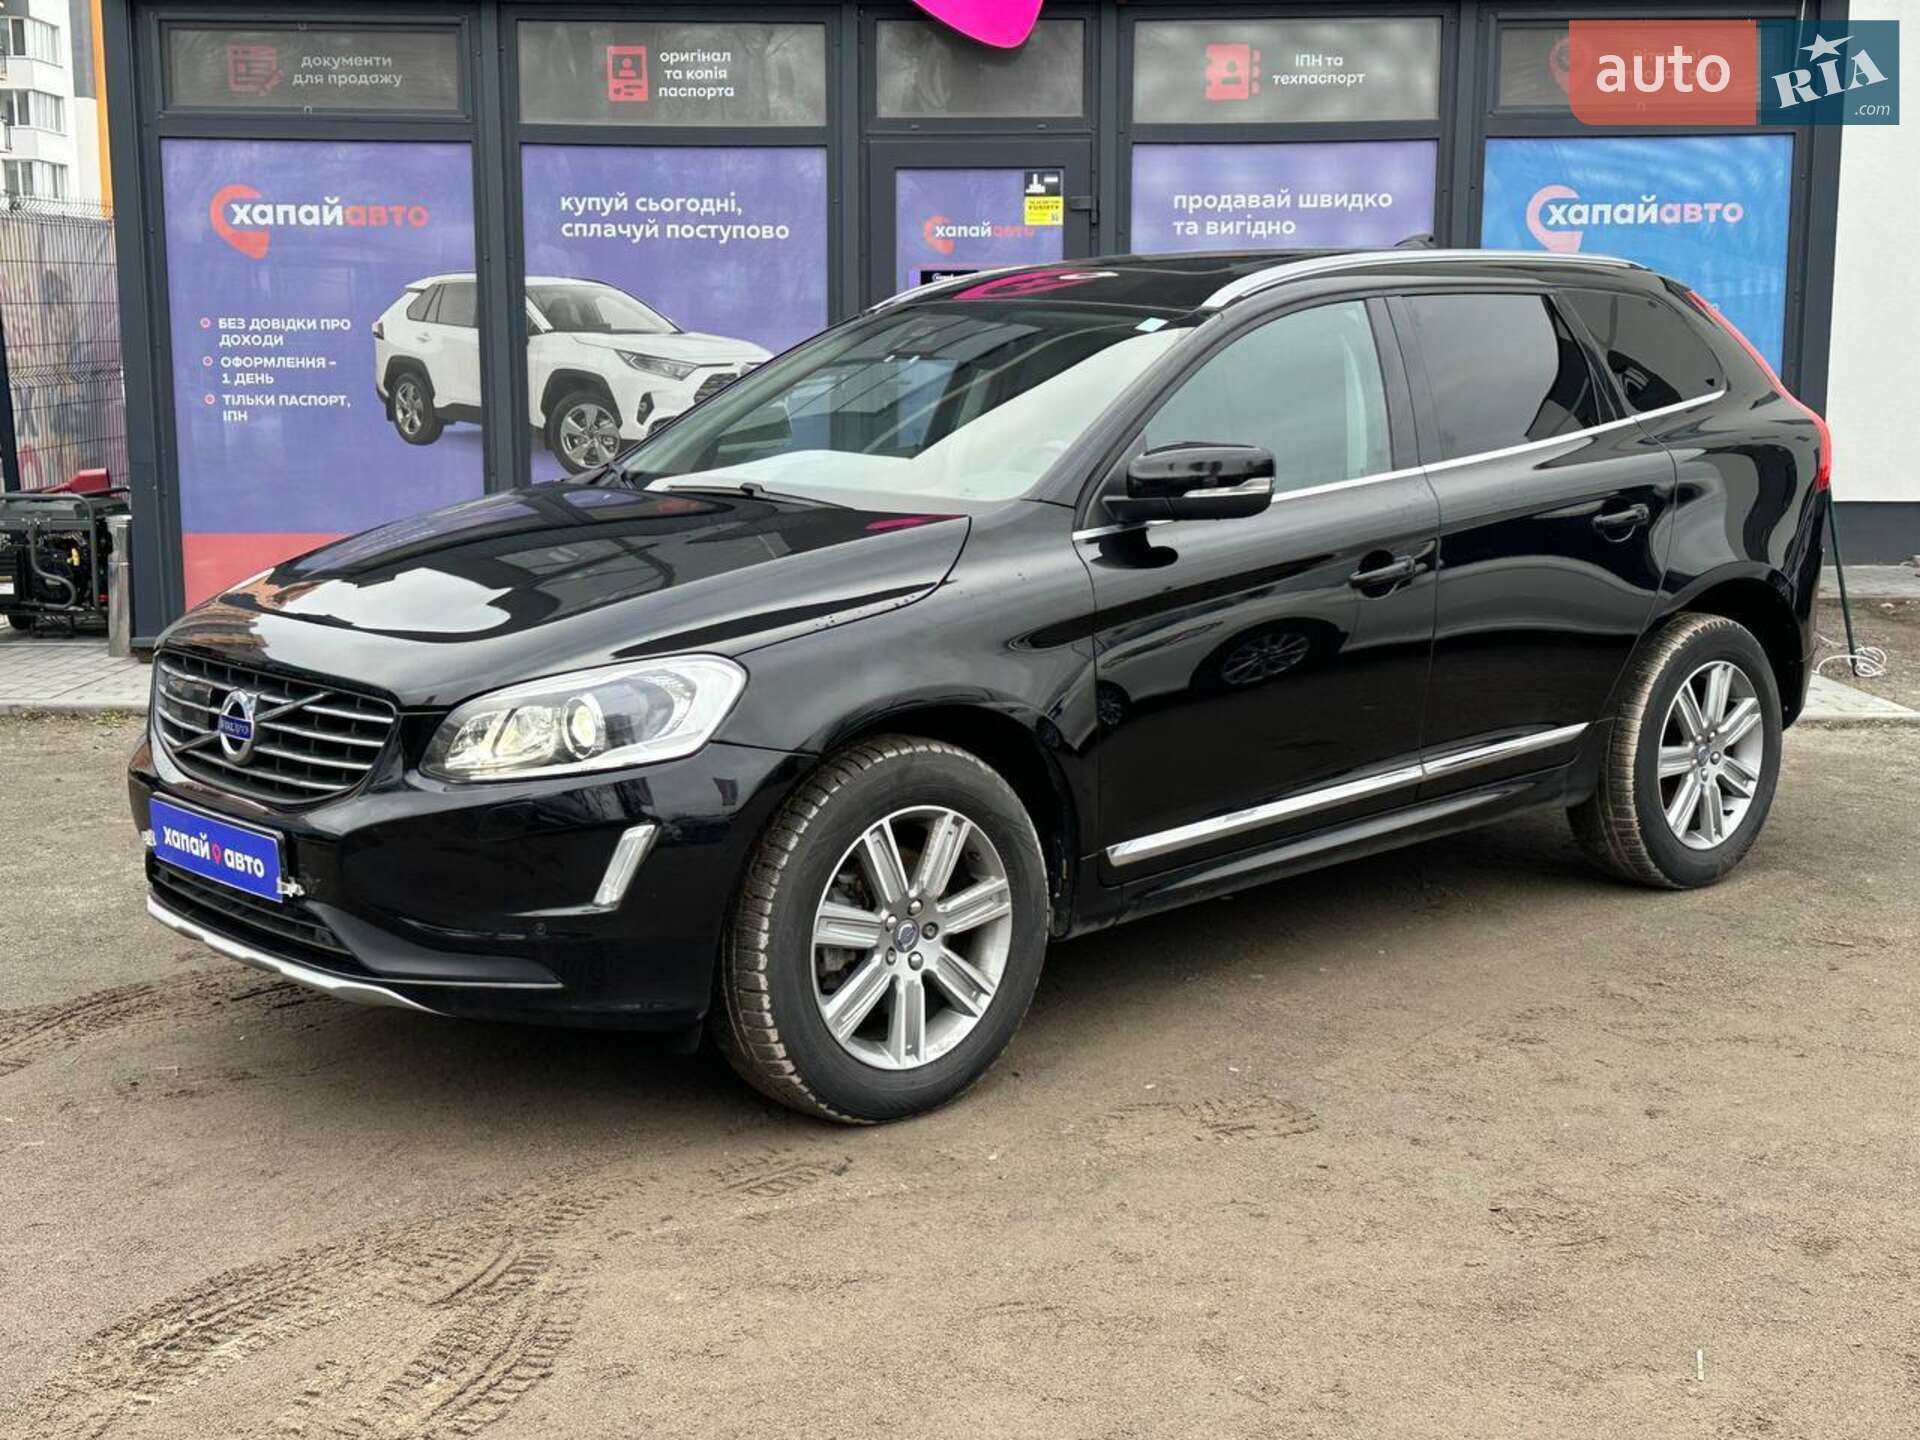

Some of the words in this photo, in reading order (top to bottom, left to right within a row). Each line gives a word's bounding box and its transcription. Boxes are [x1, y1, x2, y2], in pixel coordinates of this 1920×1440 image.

[301, 56, 392, 70] документи
[659, 49, 731, 65] оригінал
[1295, 54, 1322, 67] ІПН
[1325, 57, 1344, 67] та
[664, 69, 682, 80] та
[686, 66, 728, 80] копія
[1272, 73, 1366, 87] техпаспорт
[292, 74, 323, 87] для
[327, 74, 403, 88] продажу
[659, 86, 735, 100] паспорта
[560, 191, 629, 217] купуй
[635, 191, 743, 217] сьогодні,
[1173, 188, 1291, 214] продавай
[1298, 192, 1393, 212] швидко
[230, 196, 430, 228] хапайавто
[1547, 194, 1744, 225] хапайавто
[561, 218, 659, 244] сплачуй
[666, 223, 790, 244] поступово
[1173, 220, 1199, 236] та
[1205, 214, 1296, 238] вигідно
[218, 318, 246, 330] БЕЗ
[249, 318, 317, 332] ДОВІДКИ
[320, 318, 351, 330] ПРО
[219, 334, 284, 348] ДОХОДИ
[220, 357, 326, 369] ОФОРМЛЕННЯ
[222, 373, 230, 384] 1
[234, 373, 274, 386] ДЕНЬ
[222, 394, 275, 406] ТІЛЬКИ
[279, 395, 351, 408] ПАСПОРТ,
[223, 410, 248, 422] ІПН
[163, 825, 211, 860] хапай
[224, 847, 265, 878] авто
